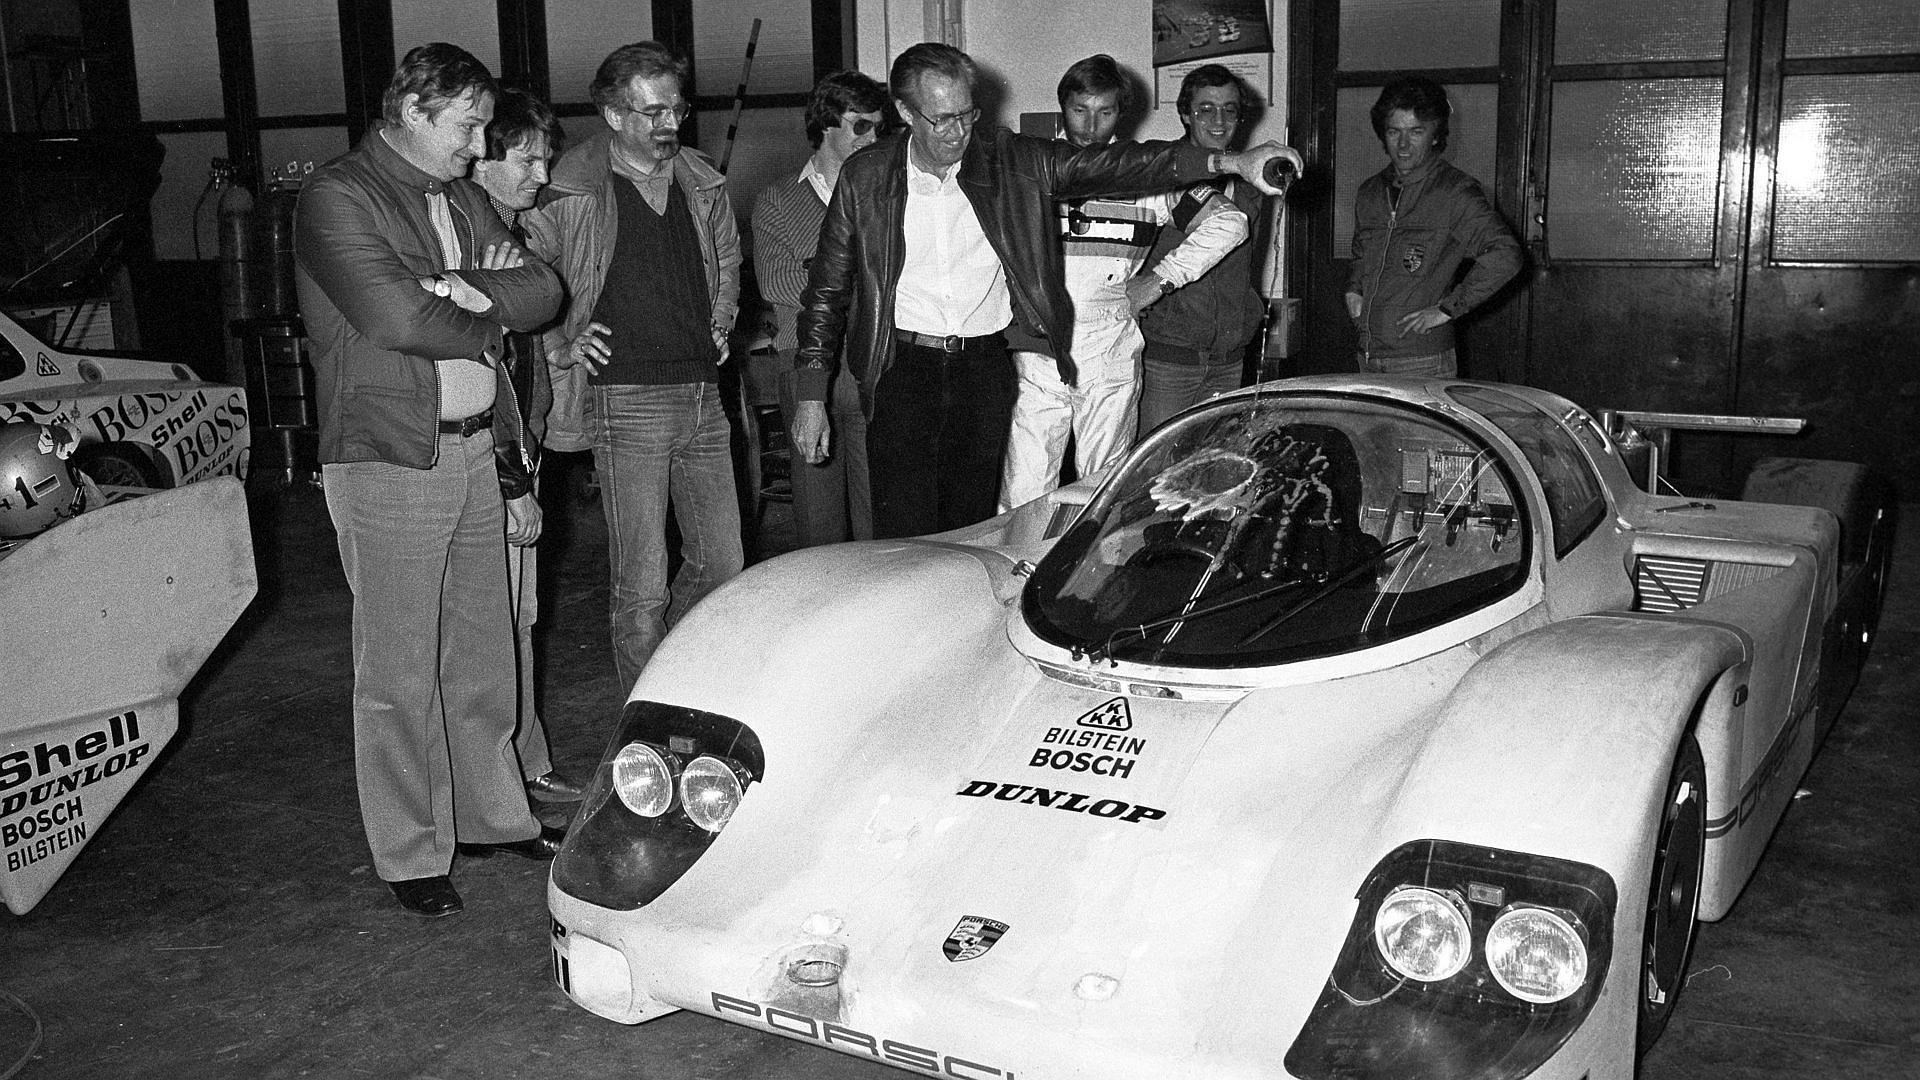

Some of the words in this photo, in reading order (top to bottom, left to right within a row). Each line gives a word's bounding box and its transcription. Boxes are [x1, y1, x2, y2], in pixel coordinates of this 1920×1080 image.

[88, 392, 182, 443] BOS
[151, 390, 208, 449] Shell
[174, 393, 248, 479] BOSS
[0, 710, 140, 792] Shell
[1029, 748, 1135, 779] BOSCH
[1043, 727, 1146, 756] BILSTEIN
[0, 742, 150, 819] DUNLOP
[956, 780, 1167, 824] DUNLOP
[1, 796, 83, 848] BOSCH
[7, 821, 87, 873] BILSTEIN
[962, 916, 1007, 932] PORSCHE
[711, 991, 1014, 1080] PORSC
